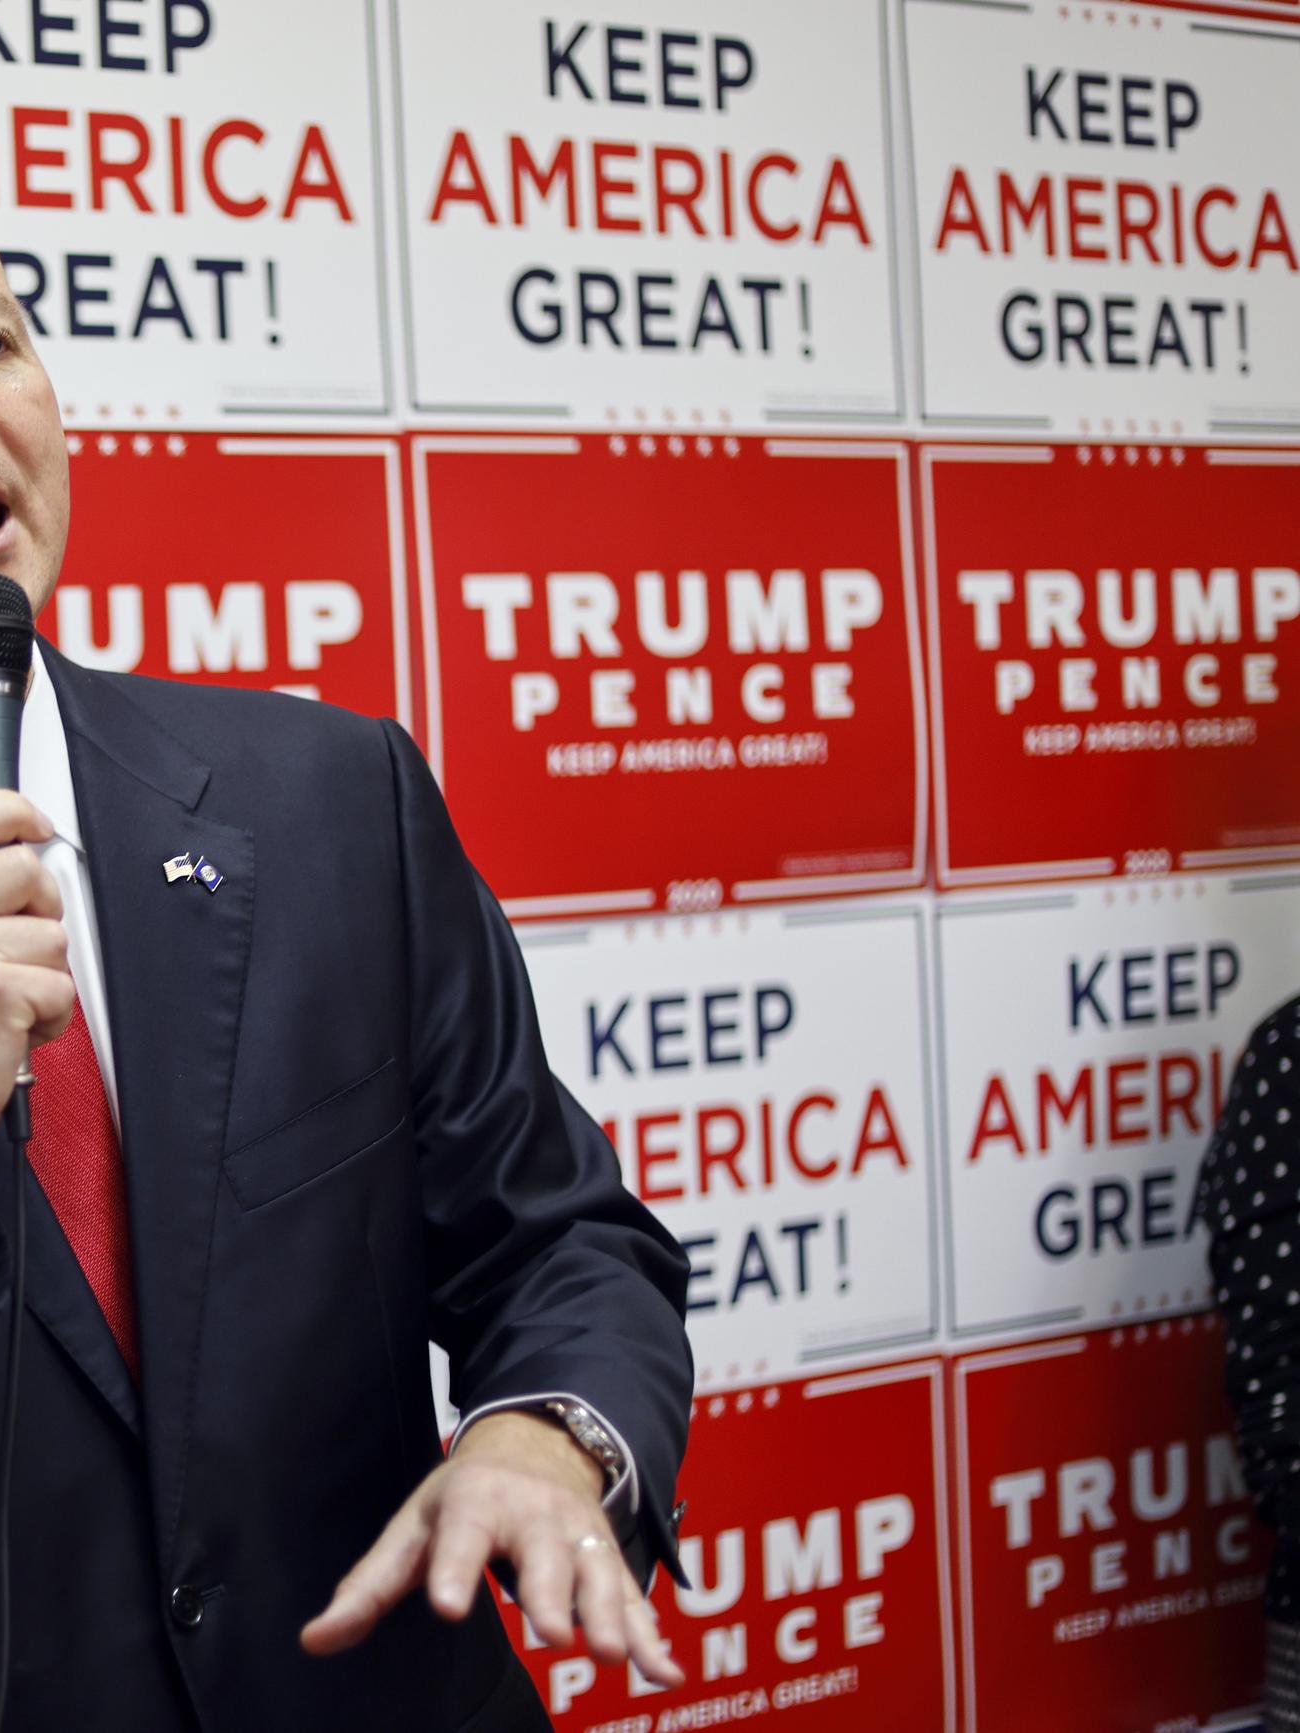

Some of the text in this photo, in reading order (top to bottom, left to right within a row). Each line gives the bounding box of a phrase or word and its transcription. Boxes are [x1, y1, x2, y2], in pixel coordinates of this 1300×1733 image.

[545, 19, 756, 112] KEEP
[1026, 64, 1200, 150] KEEP
[427, 127, 873, 249] AMERICA
[935, 164, 1300, 273] AMERICA
[510, 266, 814, 360] GREAT!
[1000, 290, 1250, 377] GREAT!
[56, 579, 364, 674] UMP
[461, 568, 884, 662] TRUMP
[957, 567, 1300, 651] TRUMP
[510, 662, 855, 732] PENCE
[994, 652, 1279, 716] PENCE
[546, 742, 617, 778] KEEP
[620, 735, 736, 774] AMERICA
[586, 984, 797, 1080] KEEP
[1067, 942, 1241, 1031] KEEP
[602, 1082, 909, 1206] ERICA
[967, 1045, 1224, 1165] AMERI
[681, 1209, 850, 1313] EAT!
[1035, 1168, 1206, 1264] GRE
[989, 1432, 1248, 1549] TRUM
[1026, 1515, 1252, 1608] PENC
